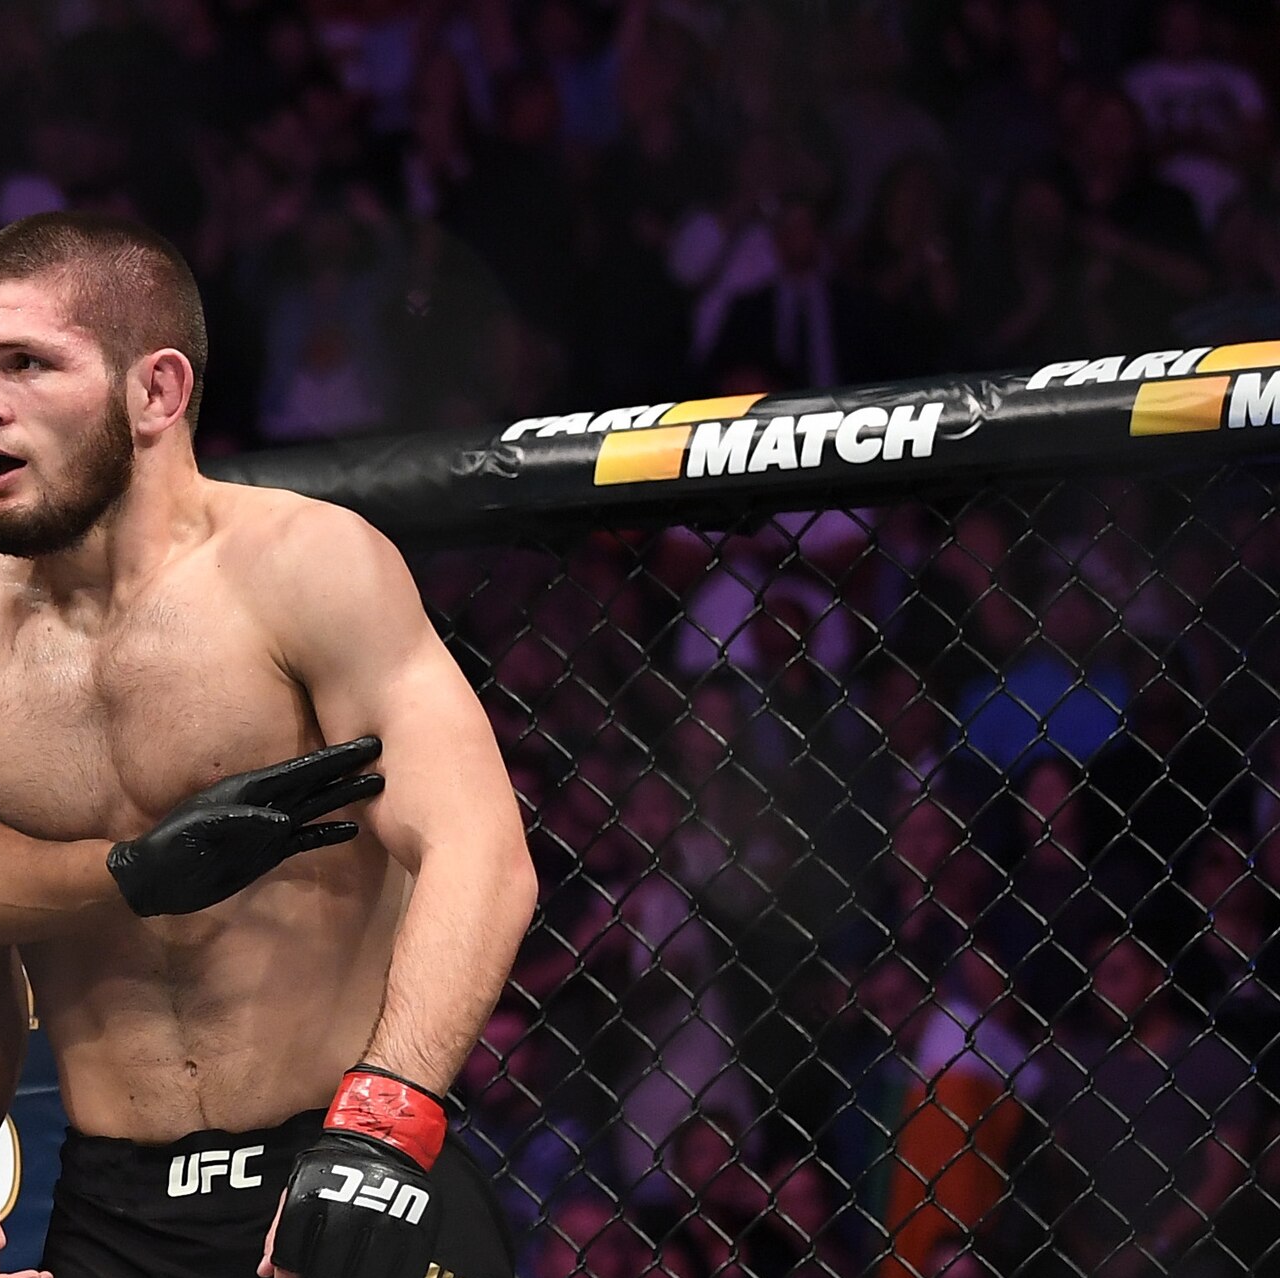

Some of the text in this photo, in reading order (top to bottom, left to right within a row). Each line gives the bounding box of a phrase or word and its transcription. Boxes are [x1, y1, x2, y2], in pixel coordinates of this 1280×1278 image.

[1026, 347, 1214, 390] PARI
[500, 403, 676, 441] PARI
[686, 403, 944, 478] MATCH
[168, 1145, 264, 1198] UFC
[318, 1165, 430, 1225] UFC
